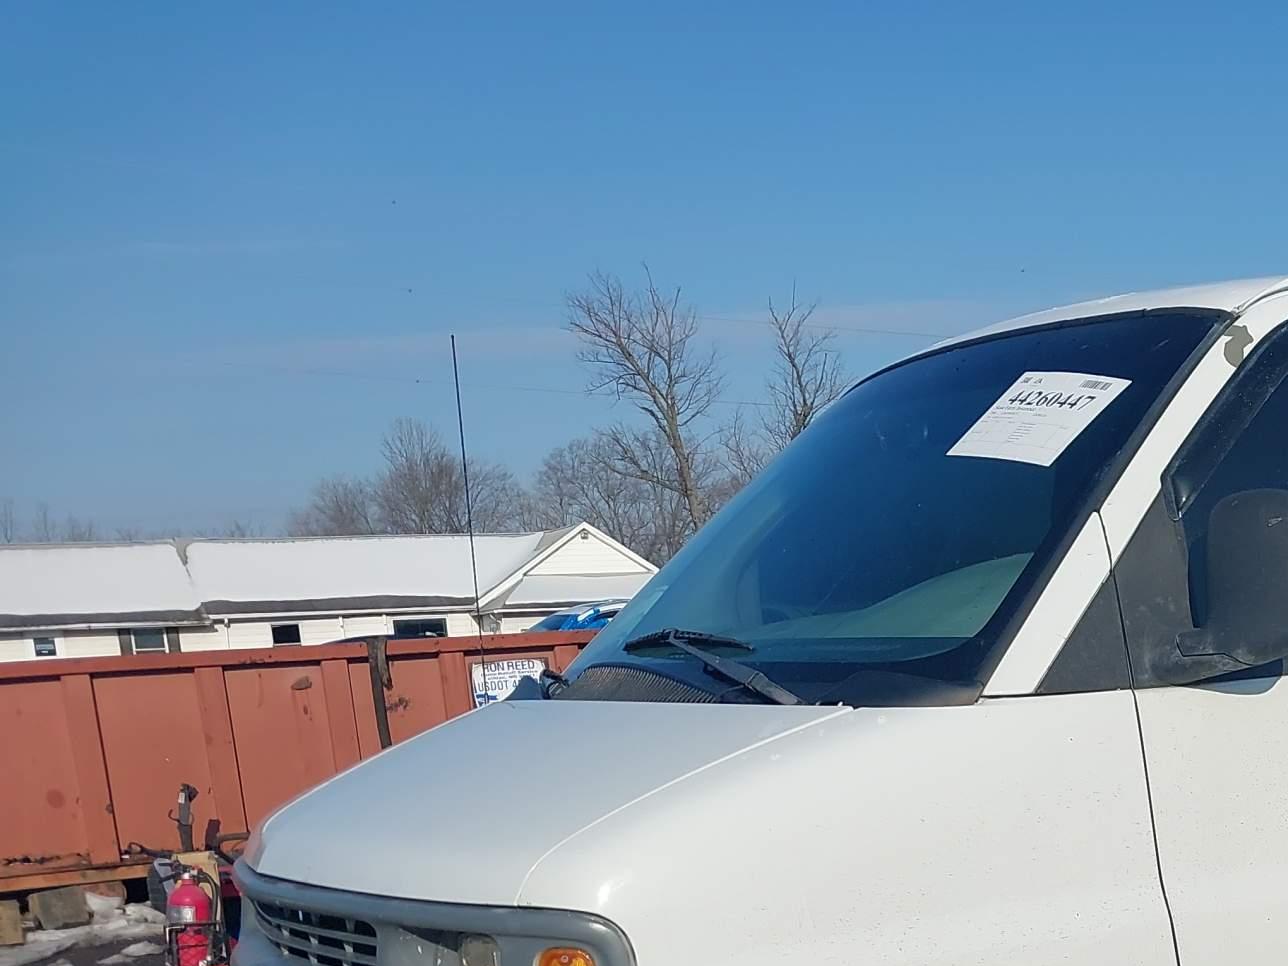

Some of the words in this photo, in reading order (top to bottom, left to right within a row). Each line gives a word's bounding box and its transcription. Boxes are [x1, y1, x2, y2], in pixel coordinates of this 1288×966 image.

[1008, 390, 1097, 411] 44260447
[507, 660, 535, 671] REED
[477, 679, 508, 691] USDOT
